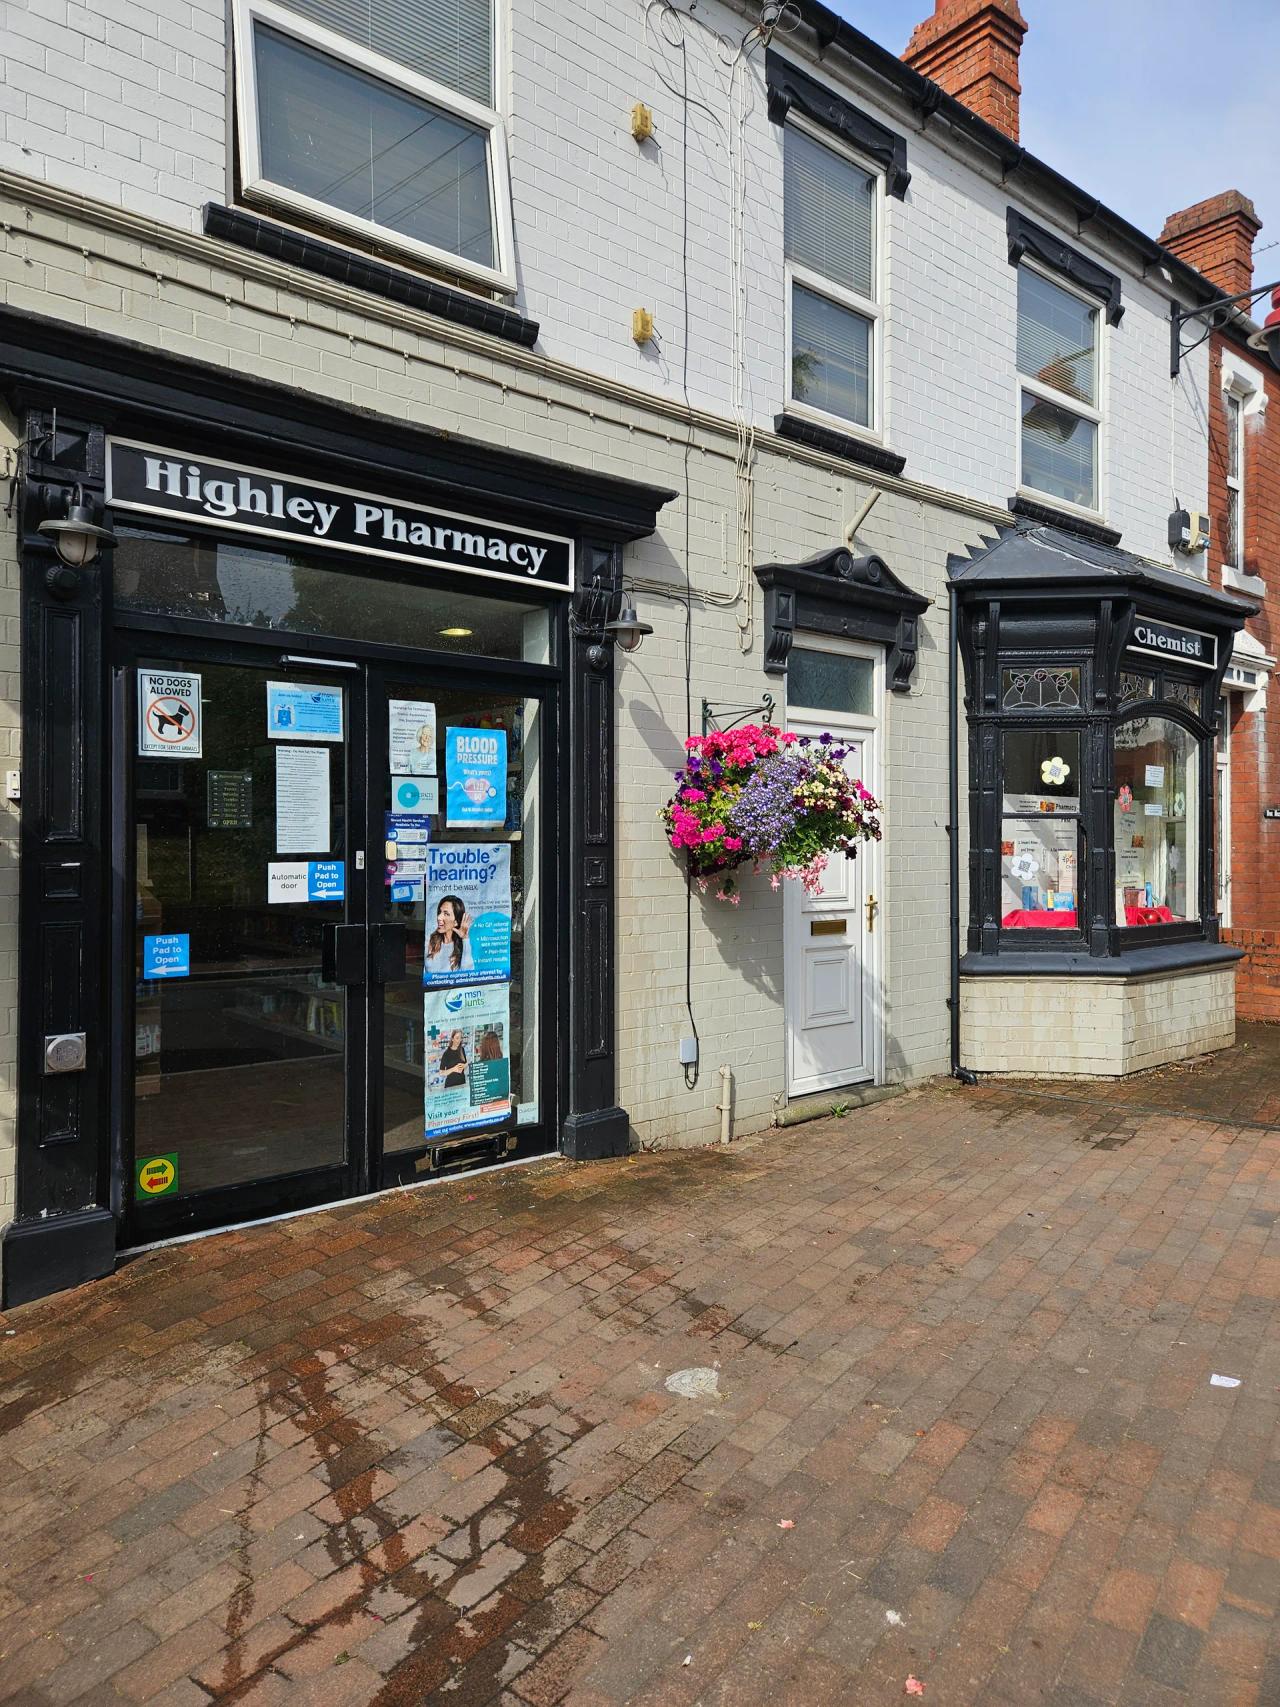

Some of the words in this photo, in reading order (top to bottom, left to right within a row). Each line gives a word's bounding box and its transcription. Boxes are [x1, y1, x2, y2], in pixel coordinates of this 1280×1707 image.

[143, 456, 340, 536] Highley
[353, 502, 548, 575] Pharmacy
[1134, 626, 1201, 656] Chemist
[149, 677, 164, 686] NO
[167, 679, 192, 688] DOGS
[150, 686, 192, 697] ALLOWED
[456, 735, 498, 754] BLOOD
[457, 753, 498, 765] PRESSURE
[1055, 803, 1077, 811] Pharmacy
[428, 848, 490, 864] Trouble
[317, 863, 337, 871] Push
[429, 864, 497, 883] hearing?
[316, 881, 337, 889] Open
[433, 884, 452, 893] might
[155, 936, 179, 945] Push
[152, 946, 170, 955] Pad
[155, 956, 179, 965] Open
[464, 990, 482, 999] msn
[427, 1112, 444, 1120] Visit
[443, 1109, 459, 1117] your
[427, 1117, 460, 1128] Pharmacy
